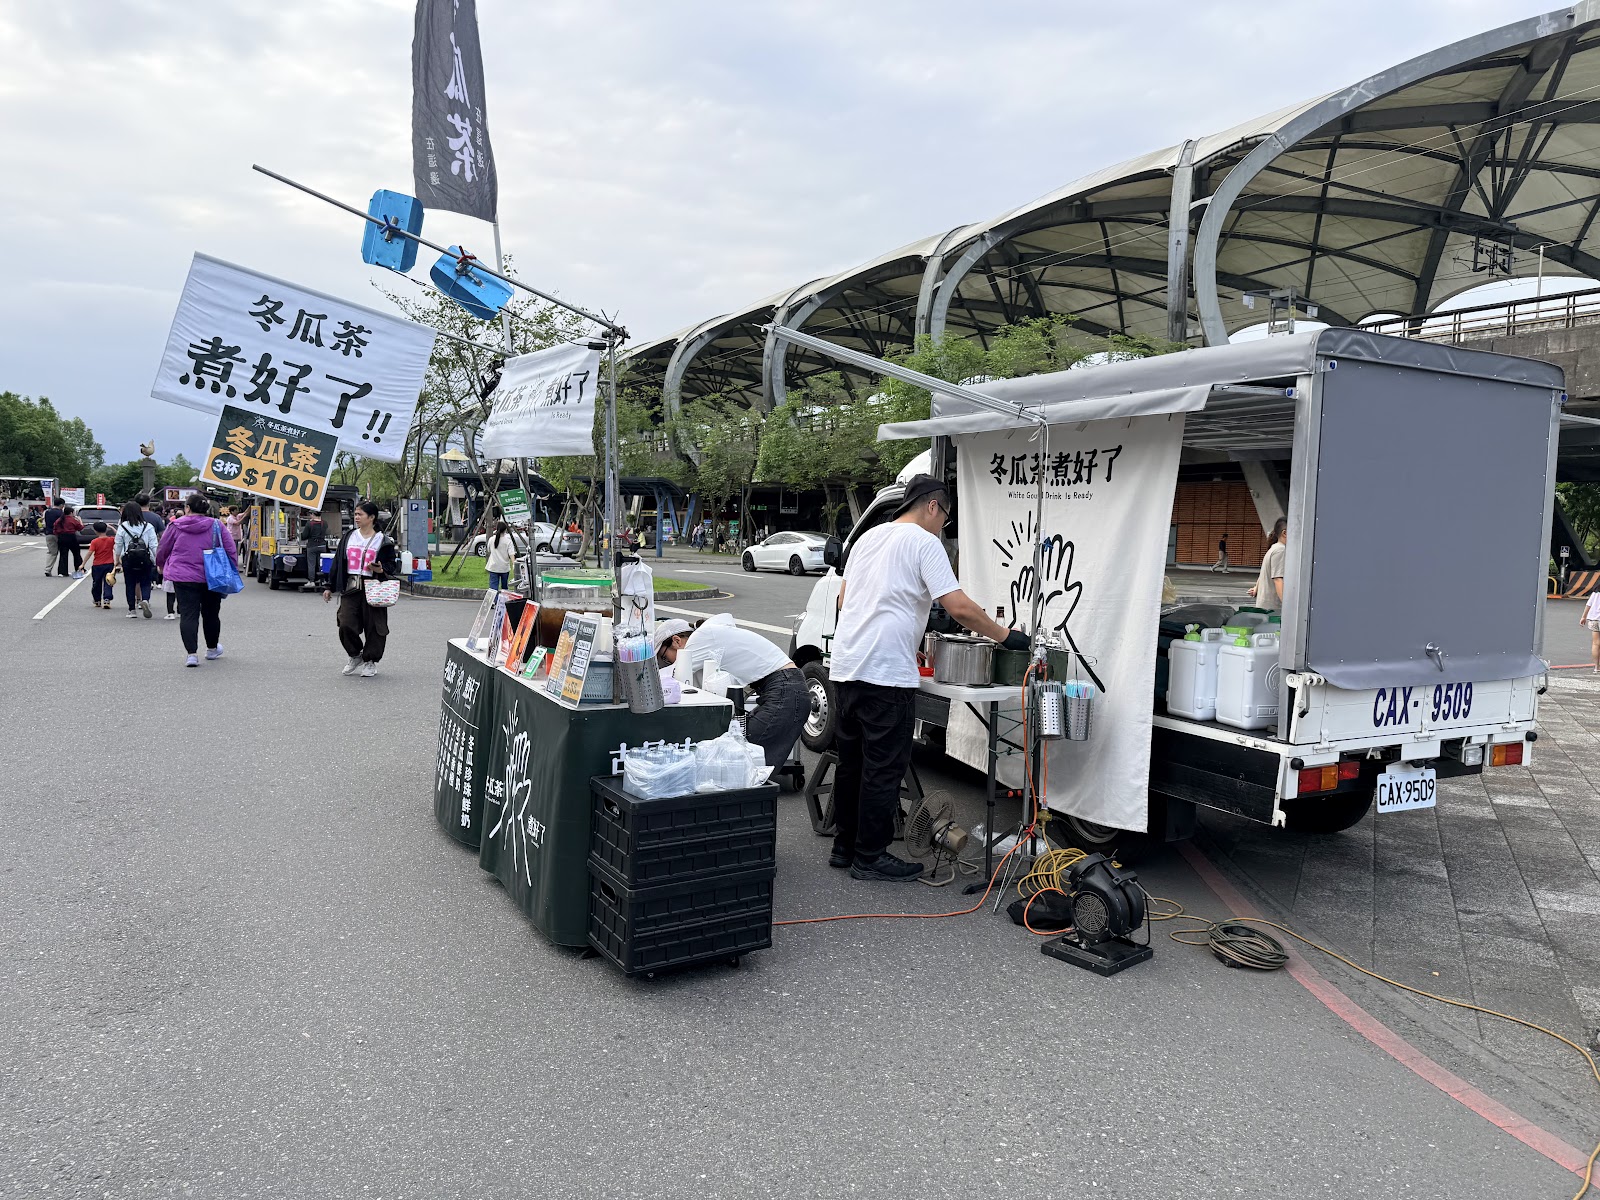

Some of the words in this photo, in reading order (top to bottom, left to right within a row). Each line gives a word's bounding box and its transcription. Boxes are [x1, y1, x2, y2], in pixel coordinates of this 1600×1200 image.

[248, 294, 373, 358] 冬瓜茶
[540, 370, 590, 408] 煮好了
[212, 458, 241, 477] 3杯
[225, 425, 321, 474] 冬瓜茶
[989, 444, 1123, 487] 冬瓜茶煮好了
[242, 467, 319, 501] $100
[1008, 491, 1025, 499] White
[1026, 491, 1044, 499] Gou
[1045, 491, 1062, 500] Drink
[1065, 492, 1071, 500] Is
[1073, 490, 1093, 500] Ready
[460, 734, 475, 829] 冬瓜珍珠鮮奶
[1379, 778, 1435, 806] CAX-9509
